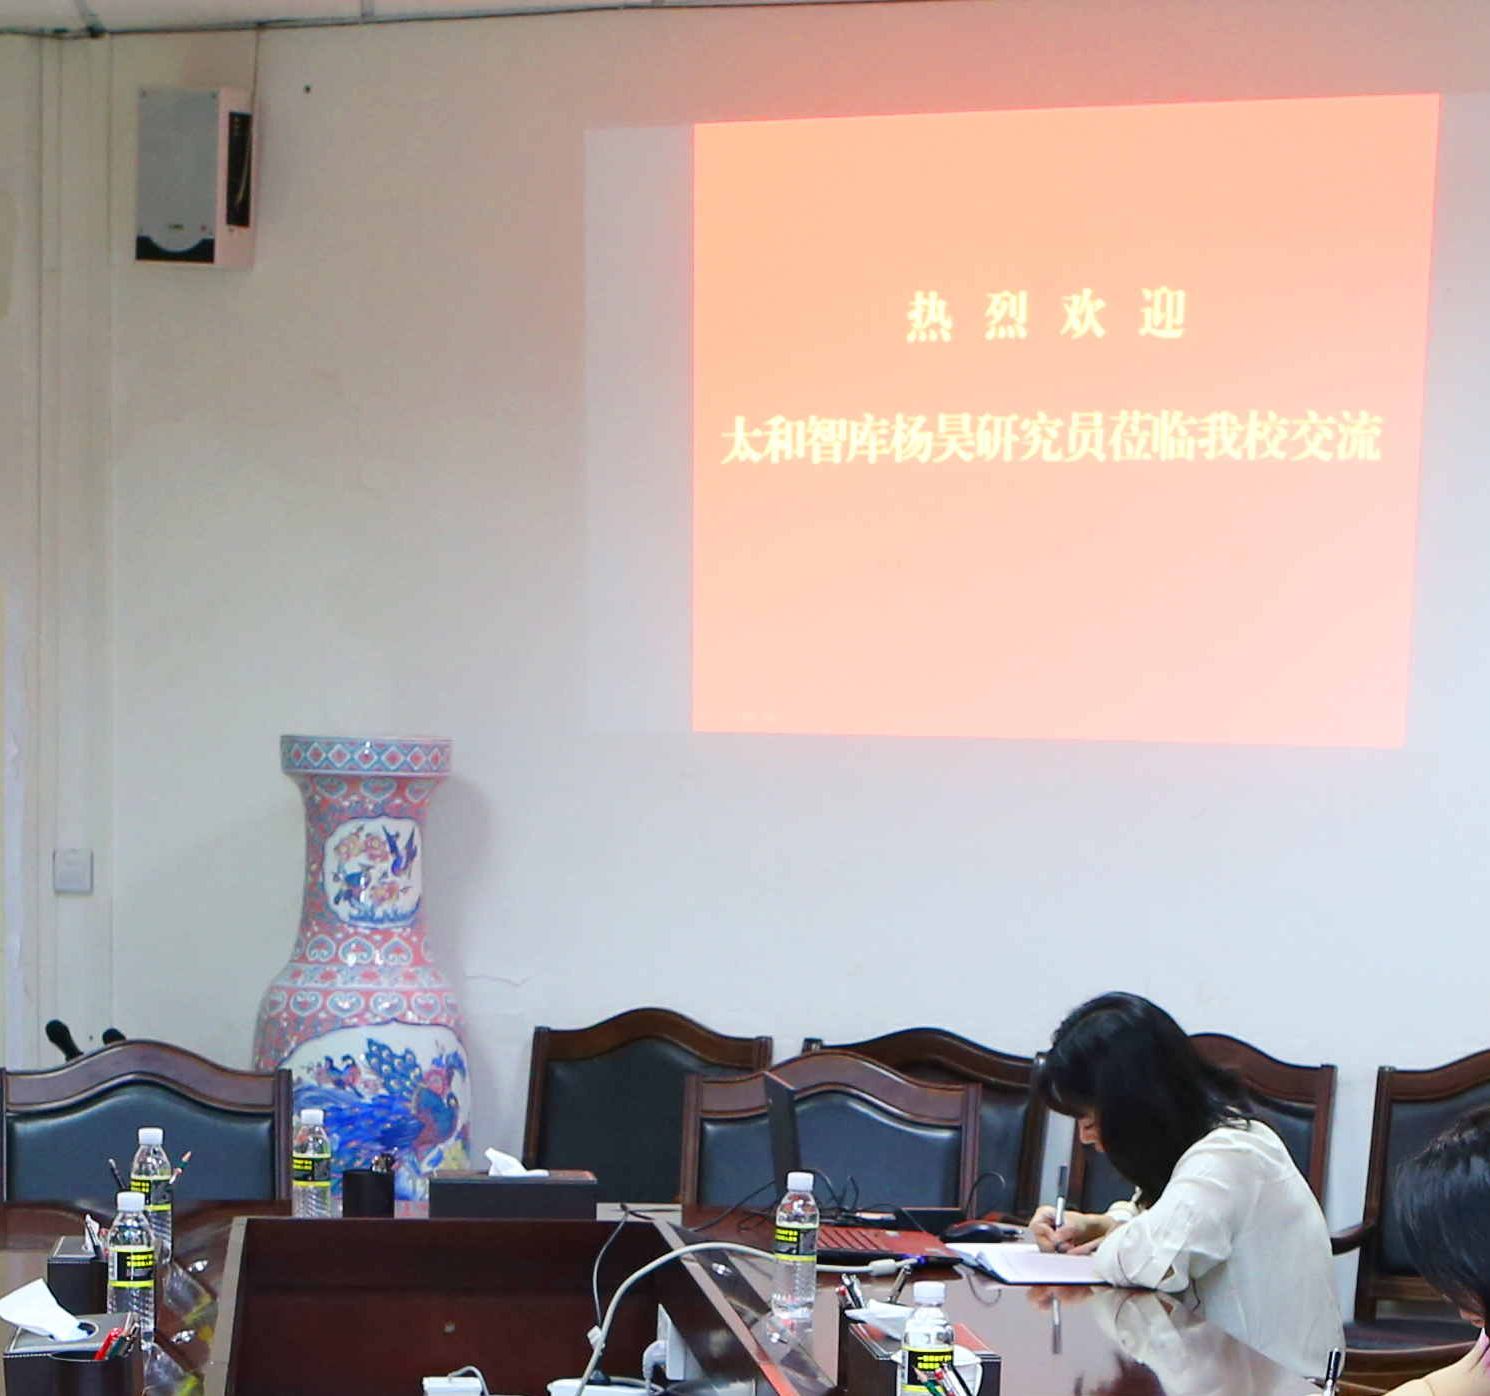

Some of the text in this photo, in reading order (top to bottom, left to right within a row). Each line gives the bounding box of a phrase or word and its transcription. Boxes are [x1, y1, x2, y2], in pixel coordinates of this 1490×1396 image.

[906, 286, 1186, 343] 热烈欢迎
[720, 409, 1384, 465] 太和智库杨昊研究员莅临我校交流
